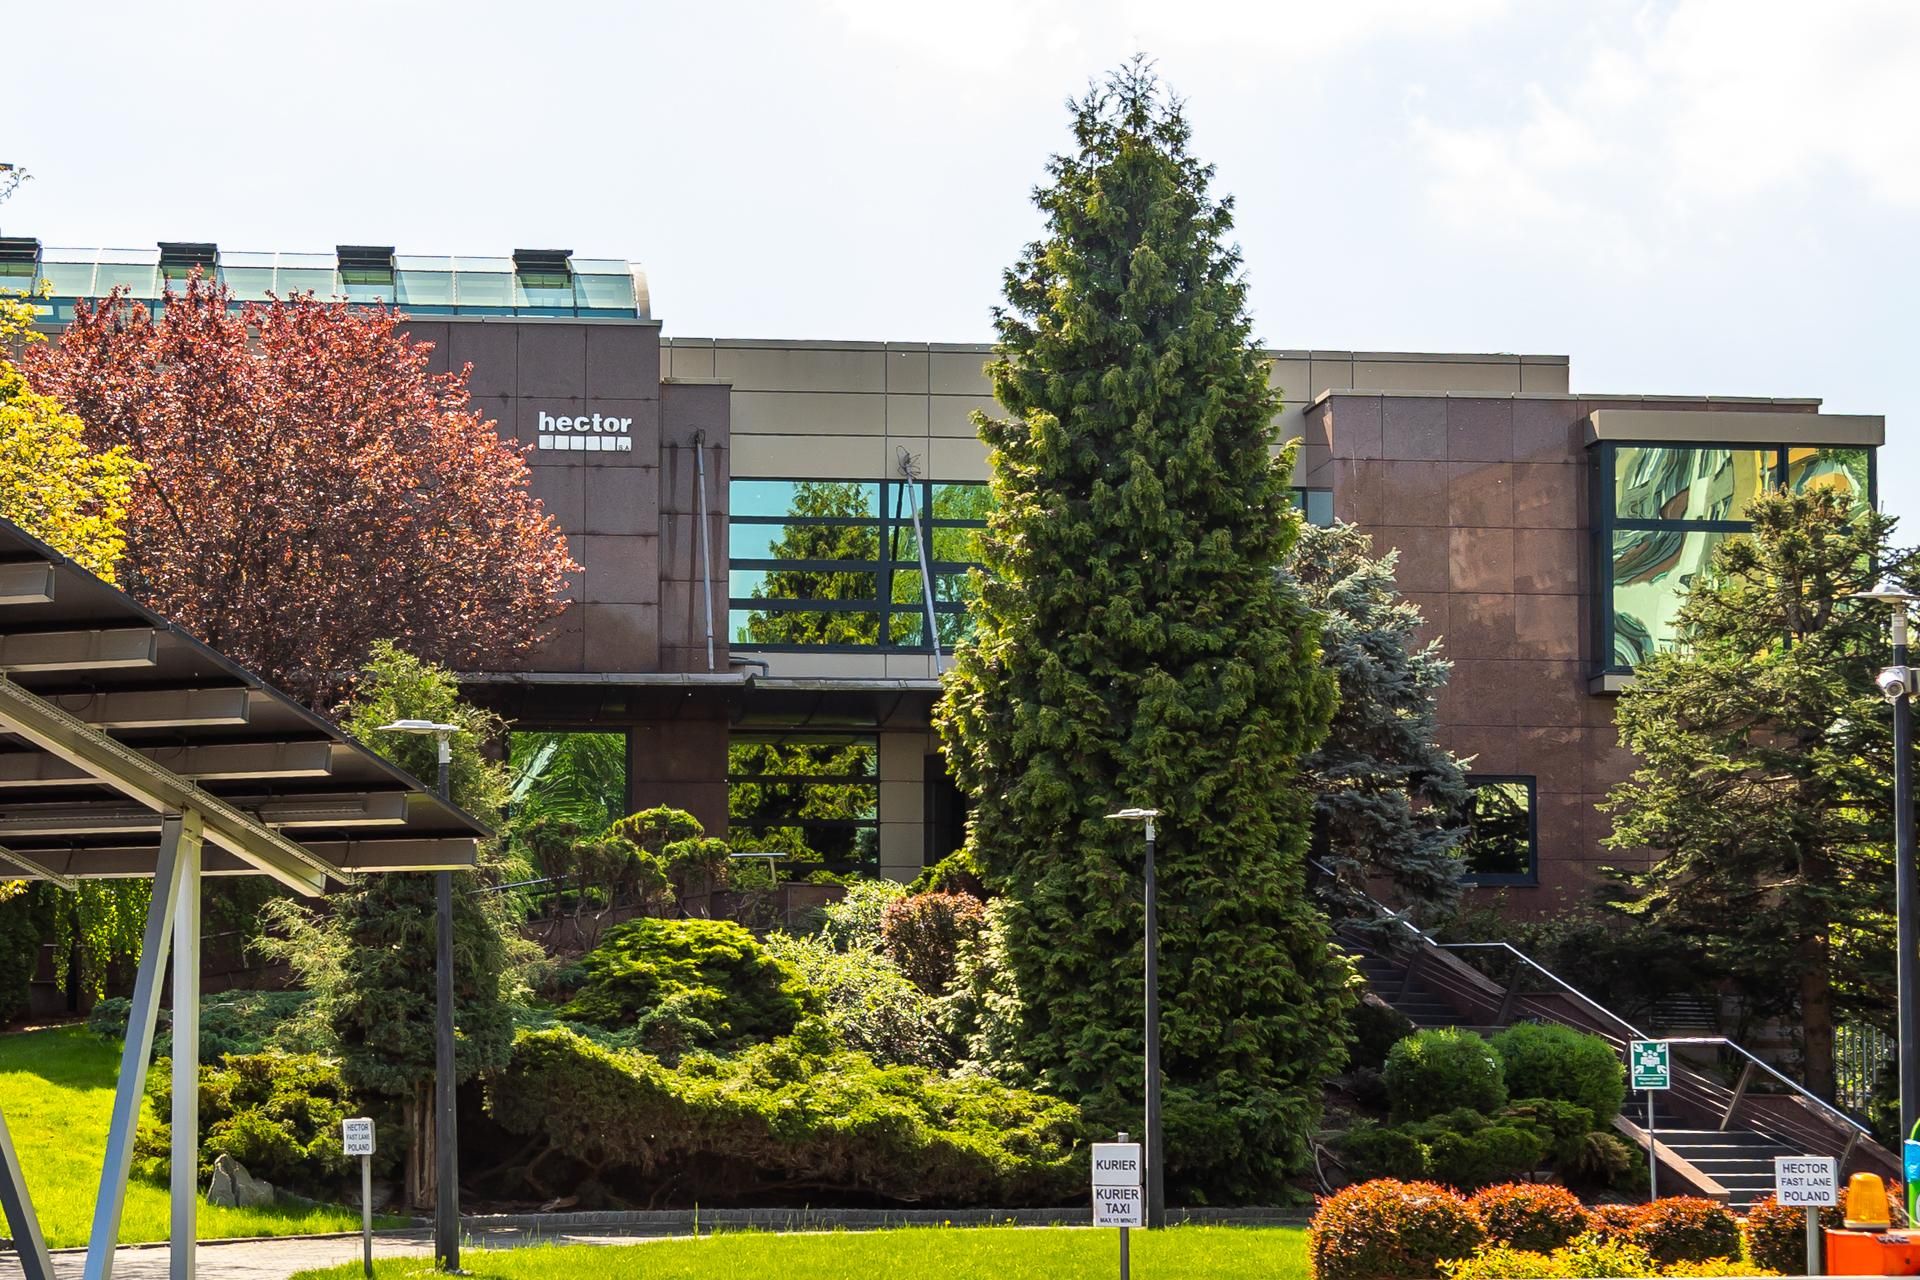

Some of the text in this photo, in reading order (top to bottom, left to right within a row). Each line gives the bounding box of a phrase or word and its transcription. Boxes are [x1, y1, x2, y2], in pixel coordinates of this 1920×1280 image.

[538, 411, 632, 433] hector
[347, 1123, 369, 1131] HECTOR
[1096, 1160, 1136, 1170] KURIER
[1782, 1163, 1829, 1173] HECTOR
[1781, 1178, 1832, 1186] FAST LANE
[1096, 1189, 1139, 1200] KURIER
[1784, 1191, 1830, 1201] POLAND
[1105, 1203, 1130, 1214] TAXI
